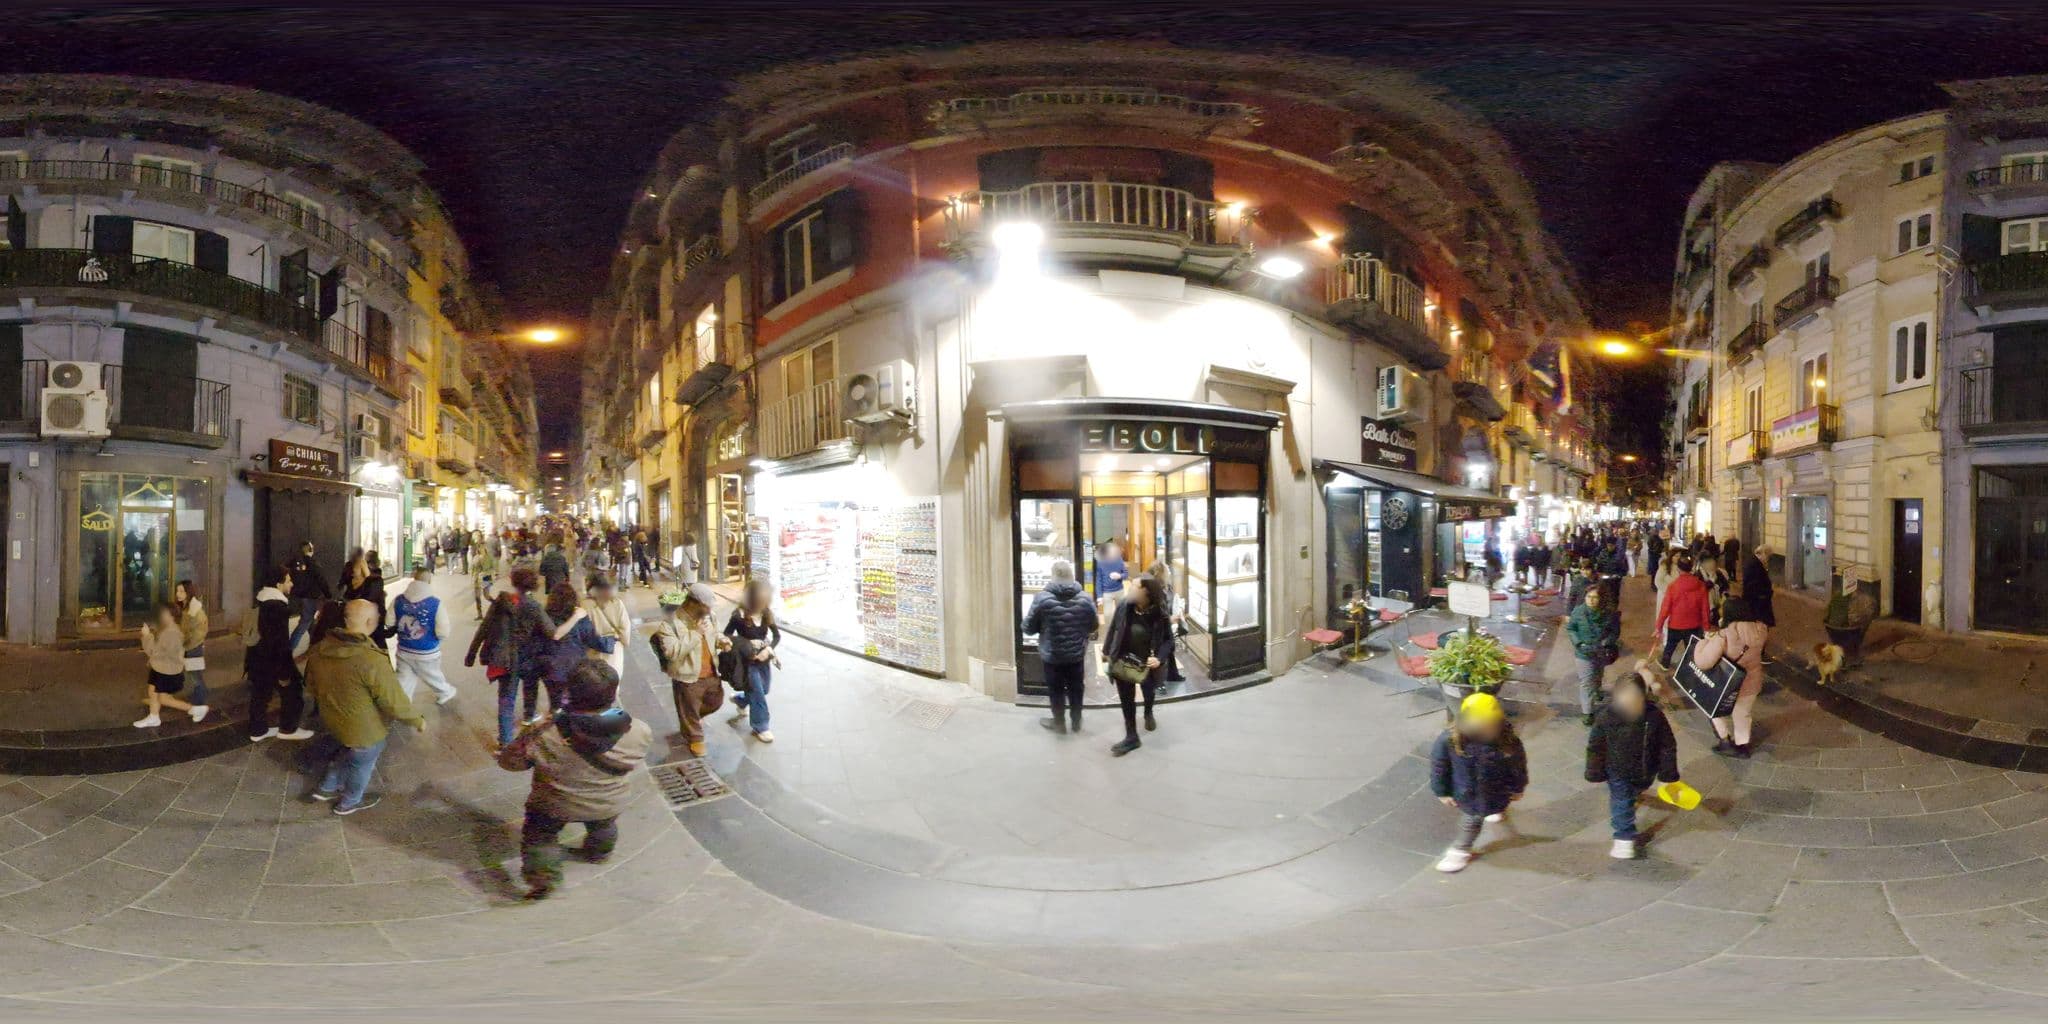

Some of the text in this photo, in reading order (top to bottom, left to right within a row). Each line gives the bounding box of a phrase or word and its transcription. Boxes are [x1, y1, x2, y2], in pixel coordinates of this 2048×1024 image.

[1080, 423, 1212, 454] EBOLI
[1363, 423, 1389, 444] Bar
[296, 447, 321, 462] CHIAIA
